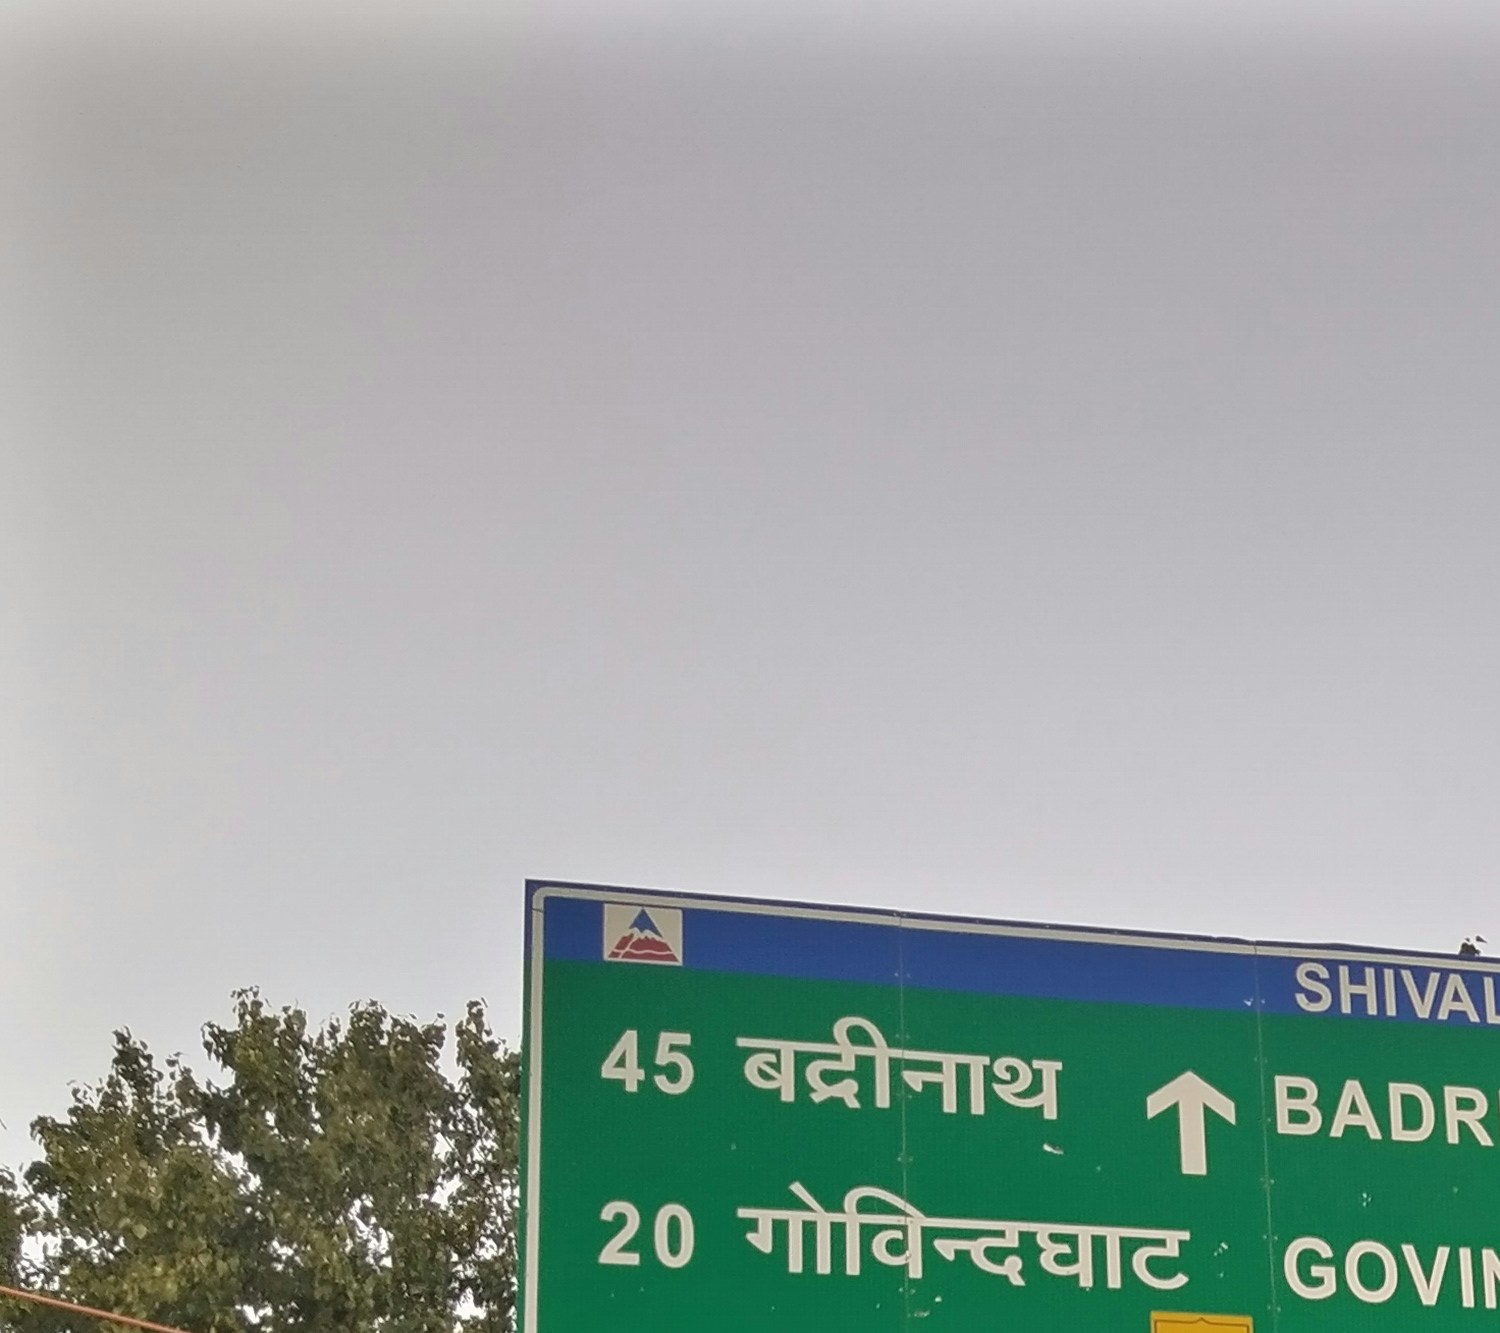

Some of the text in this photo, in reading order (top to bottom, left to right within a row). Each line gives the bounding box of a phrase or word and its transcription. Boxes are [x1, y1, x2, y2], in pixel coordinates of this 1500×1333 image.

[601, 1029, 695, 1096] 45
[736, 1016, 1063, 1120] बद्रीनाथ
[598, 1200, 695, 1270] 20
[737, 1181, 1190, 1290] गोविन्दघाट
